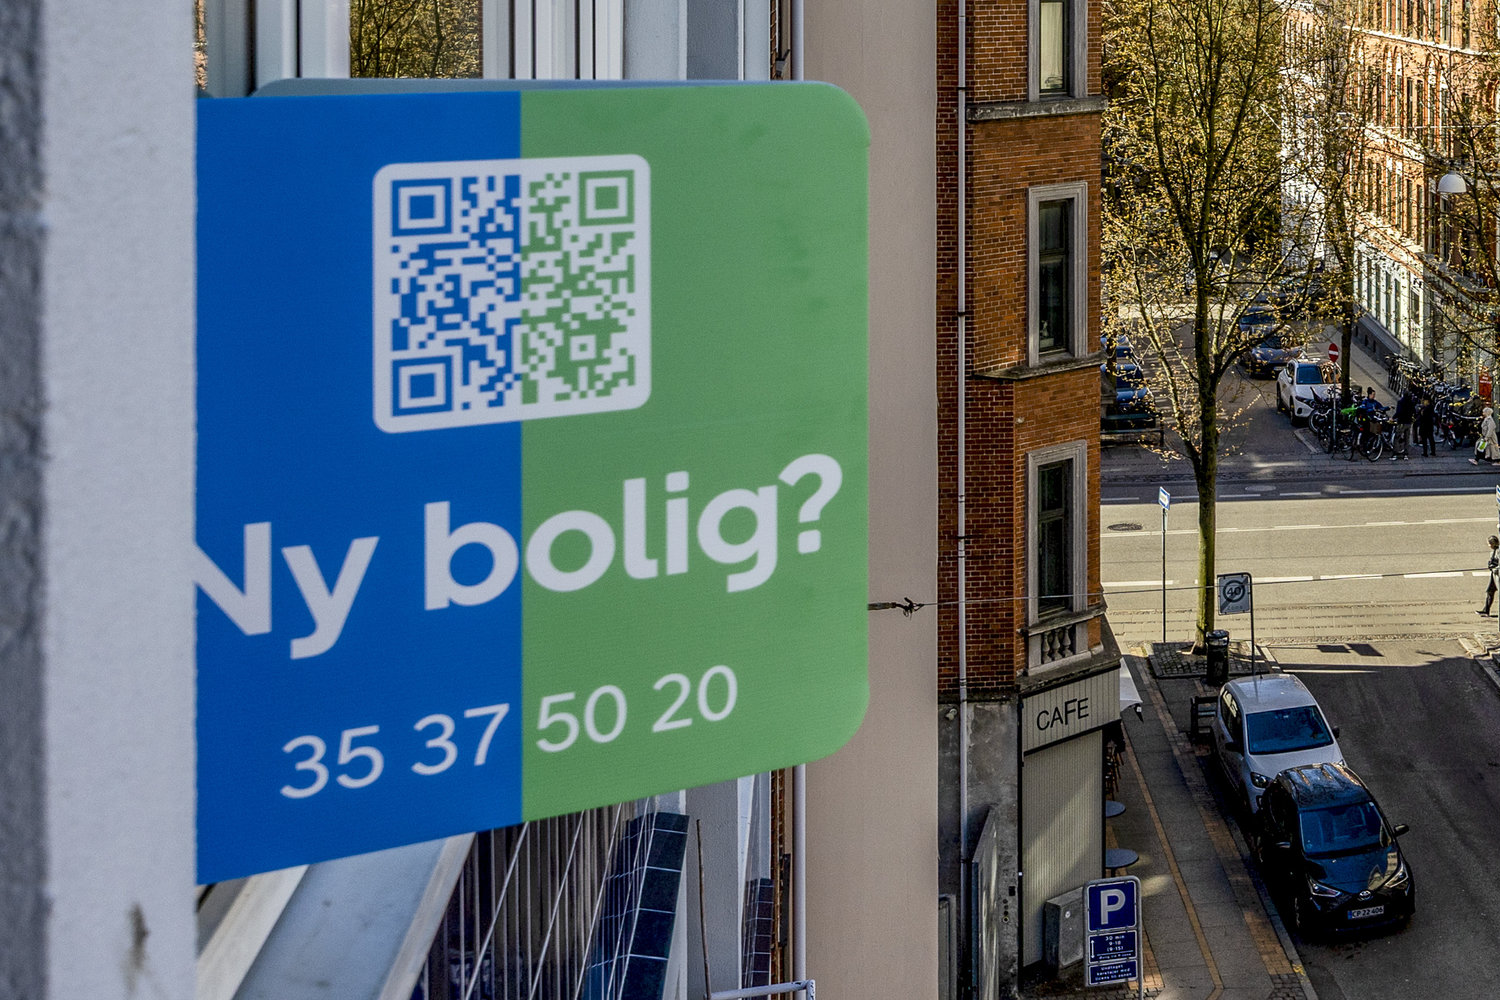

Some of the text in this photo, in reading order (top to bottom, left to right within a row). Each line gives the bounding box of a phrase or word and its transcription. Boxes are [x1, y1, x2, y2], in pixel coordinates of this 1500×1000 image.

[194, 452, 843, 660] Ny bolig?
[1227, 587, 1242, 596] 40
[280, 664, 739, 799] 35 37 50 20
[1036, 697, 1089, 731] CAFE
[1100, 888, 1126, 925] P
